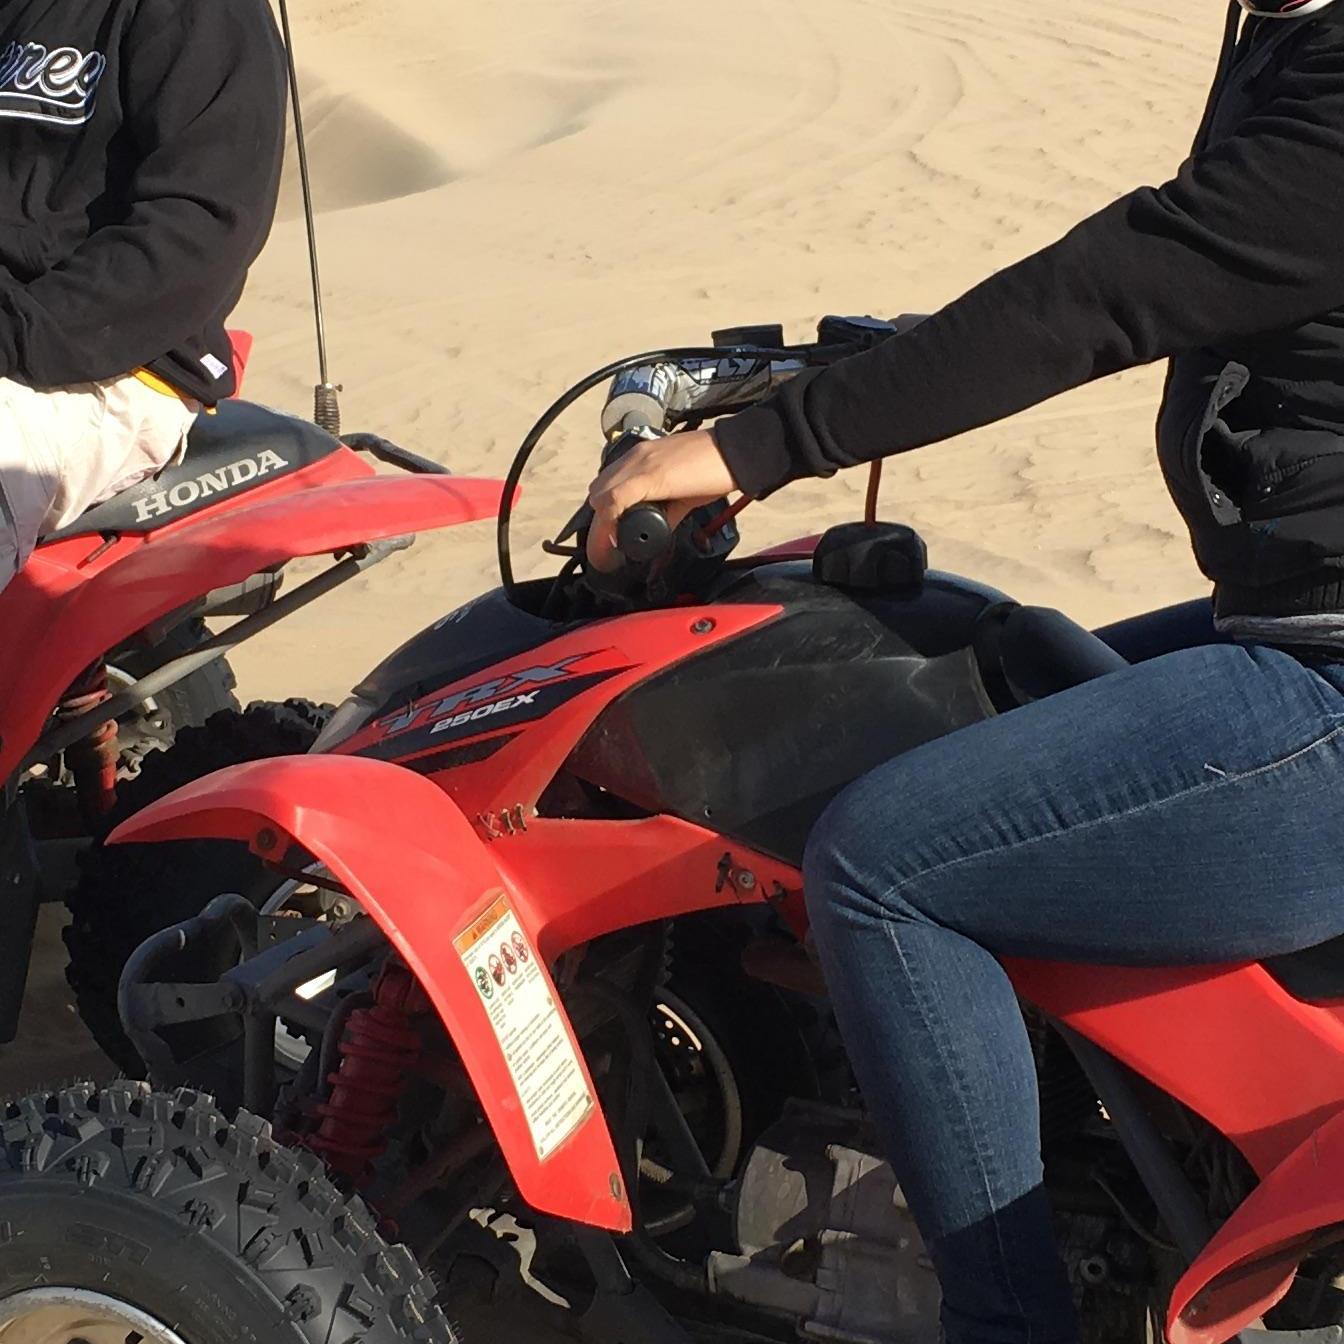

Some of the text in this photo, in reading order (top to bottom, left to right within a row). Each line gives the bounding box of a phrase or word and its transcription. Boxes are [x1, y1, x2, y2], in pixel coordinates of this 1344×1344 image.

[131, 449, 289, 523] HONDA
[378, 655, 584, 733] TRX
[429, 690, 541, 734] 250EX
